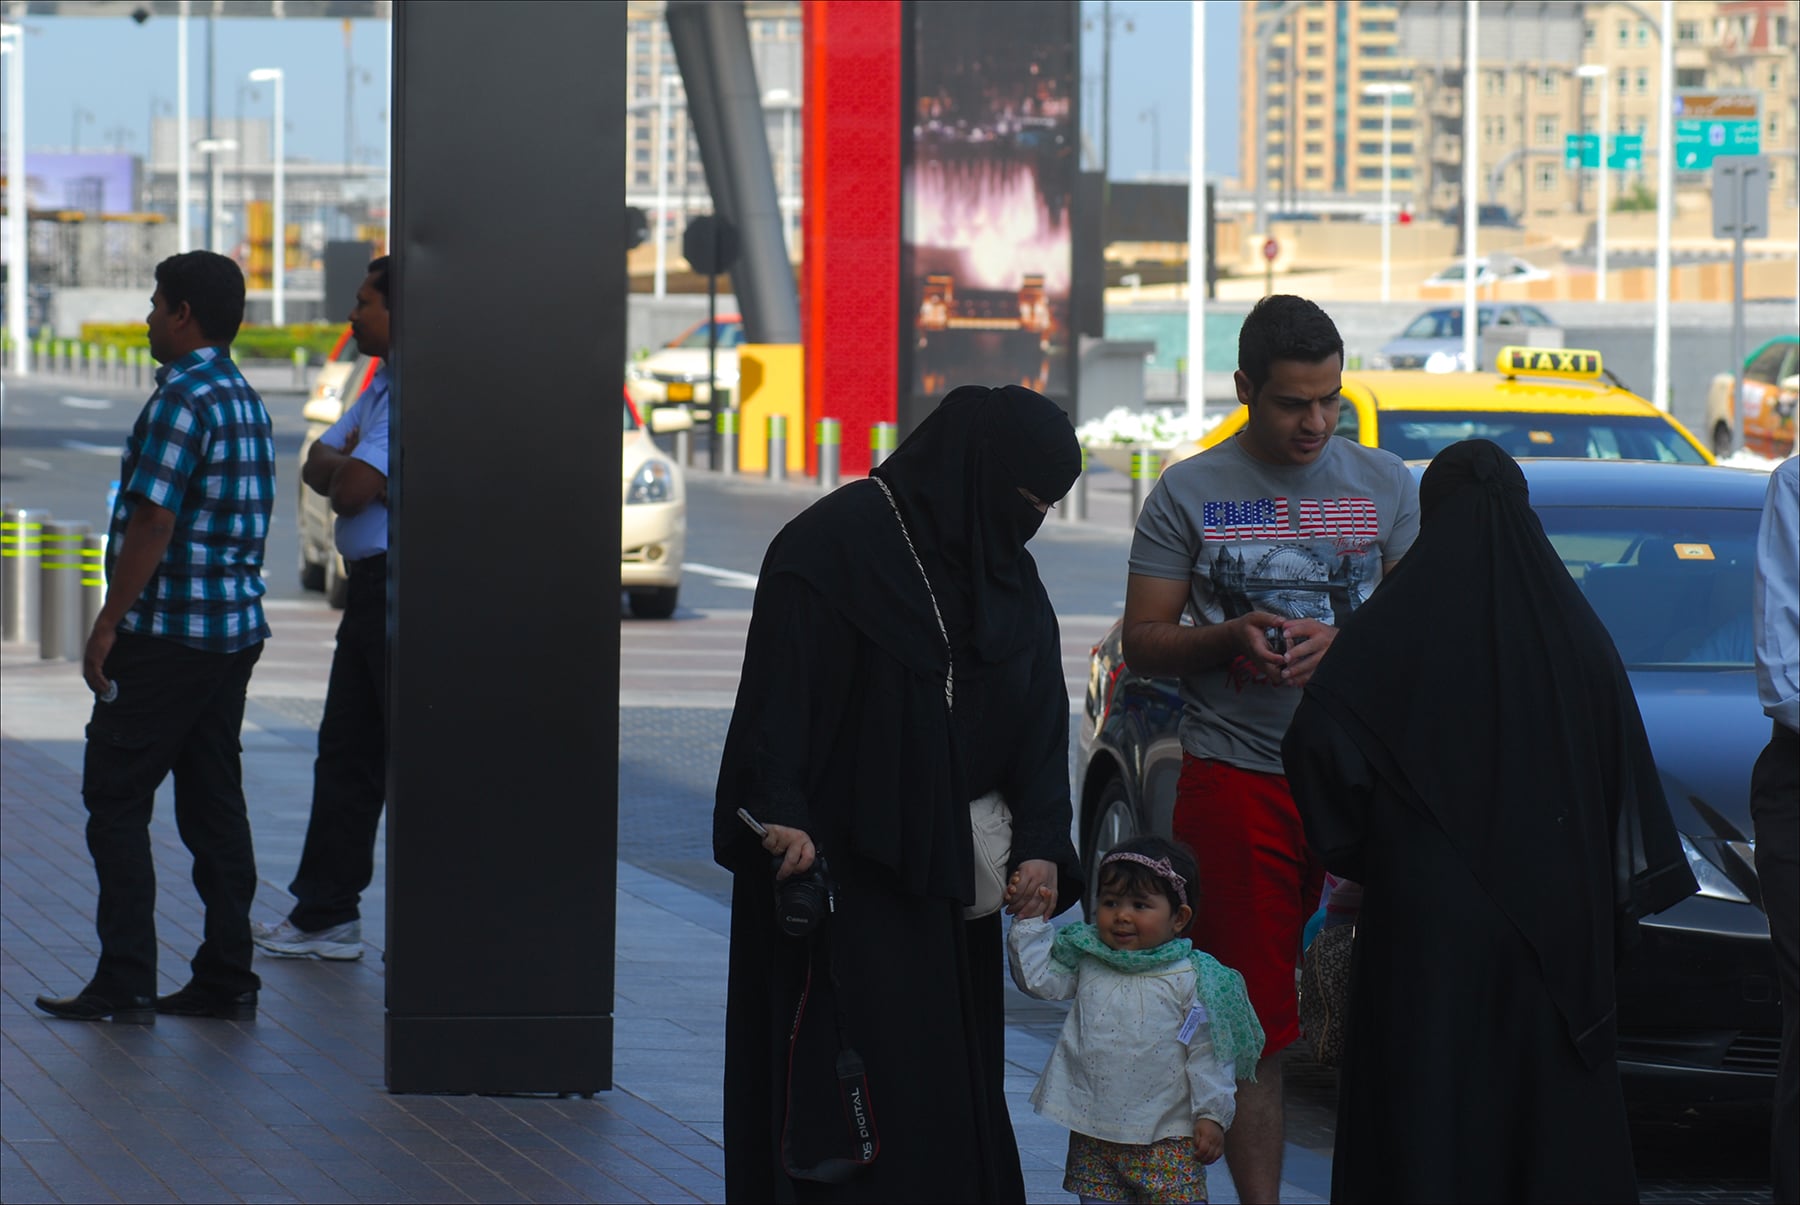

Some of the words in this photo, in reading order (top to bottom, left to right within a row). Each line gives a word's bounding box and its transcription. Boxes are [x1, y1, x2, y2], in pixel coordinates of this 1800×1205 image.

[1519, 351, 1588, 371] TAXI
[1203, 497, 1378, 541] ENGLAND
[851, 1087, 869, 1139] DIGITAL
[862, 1141, 873, 1161] OS
